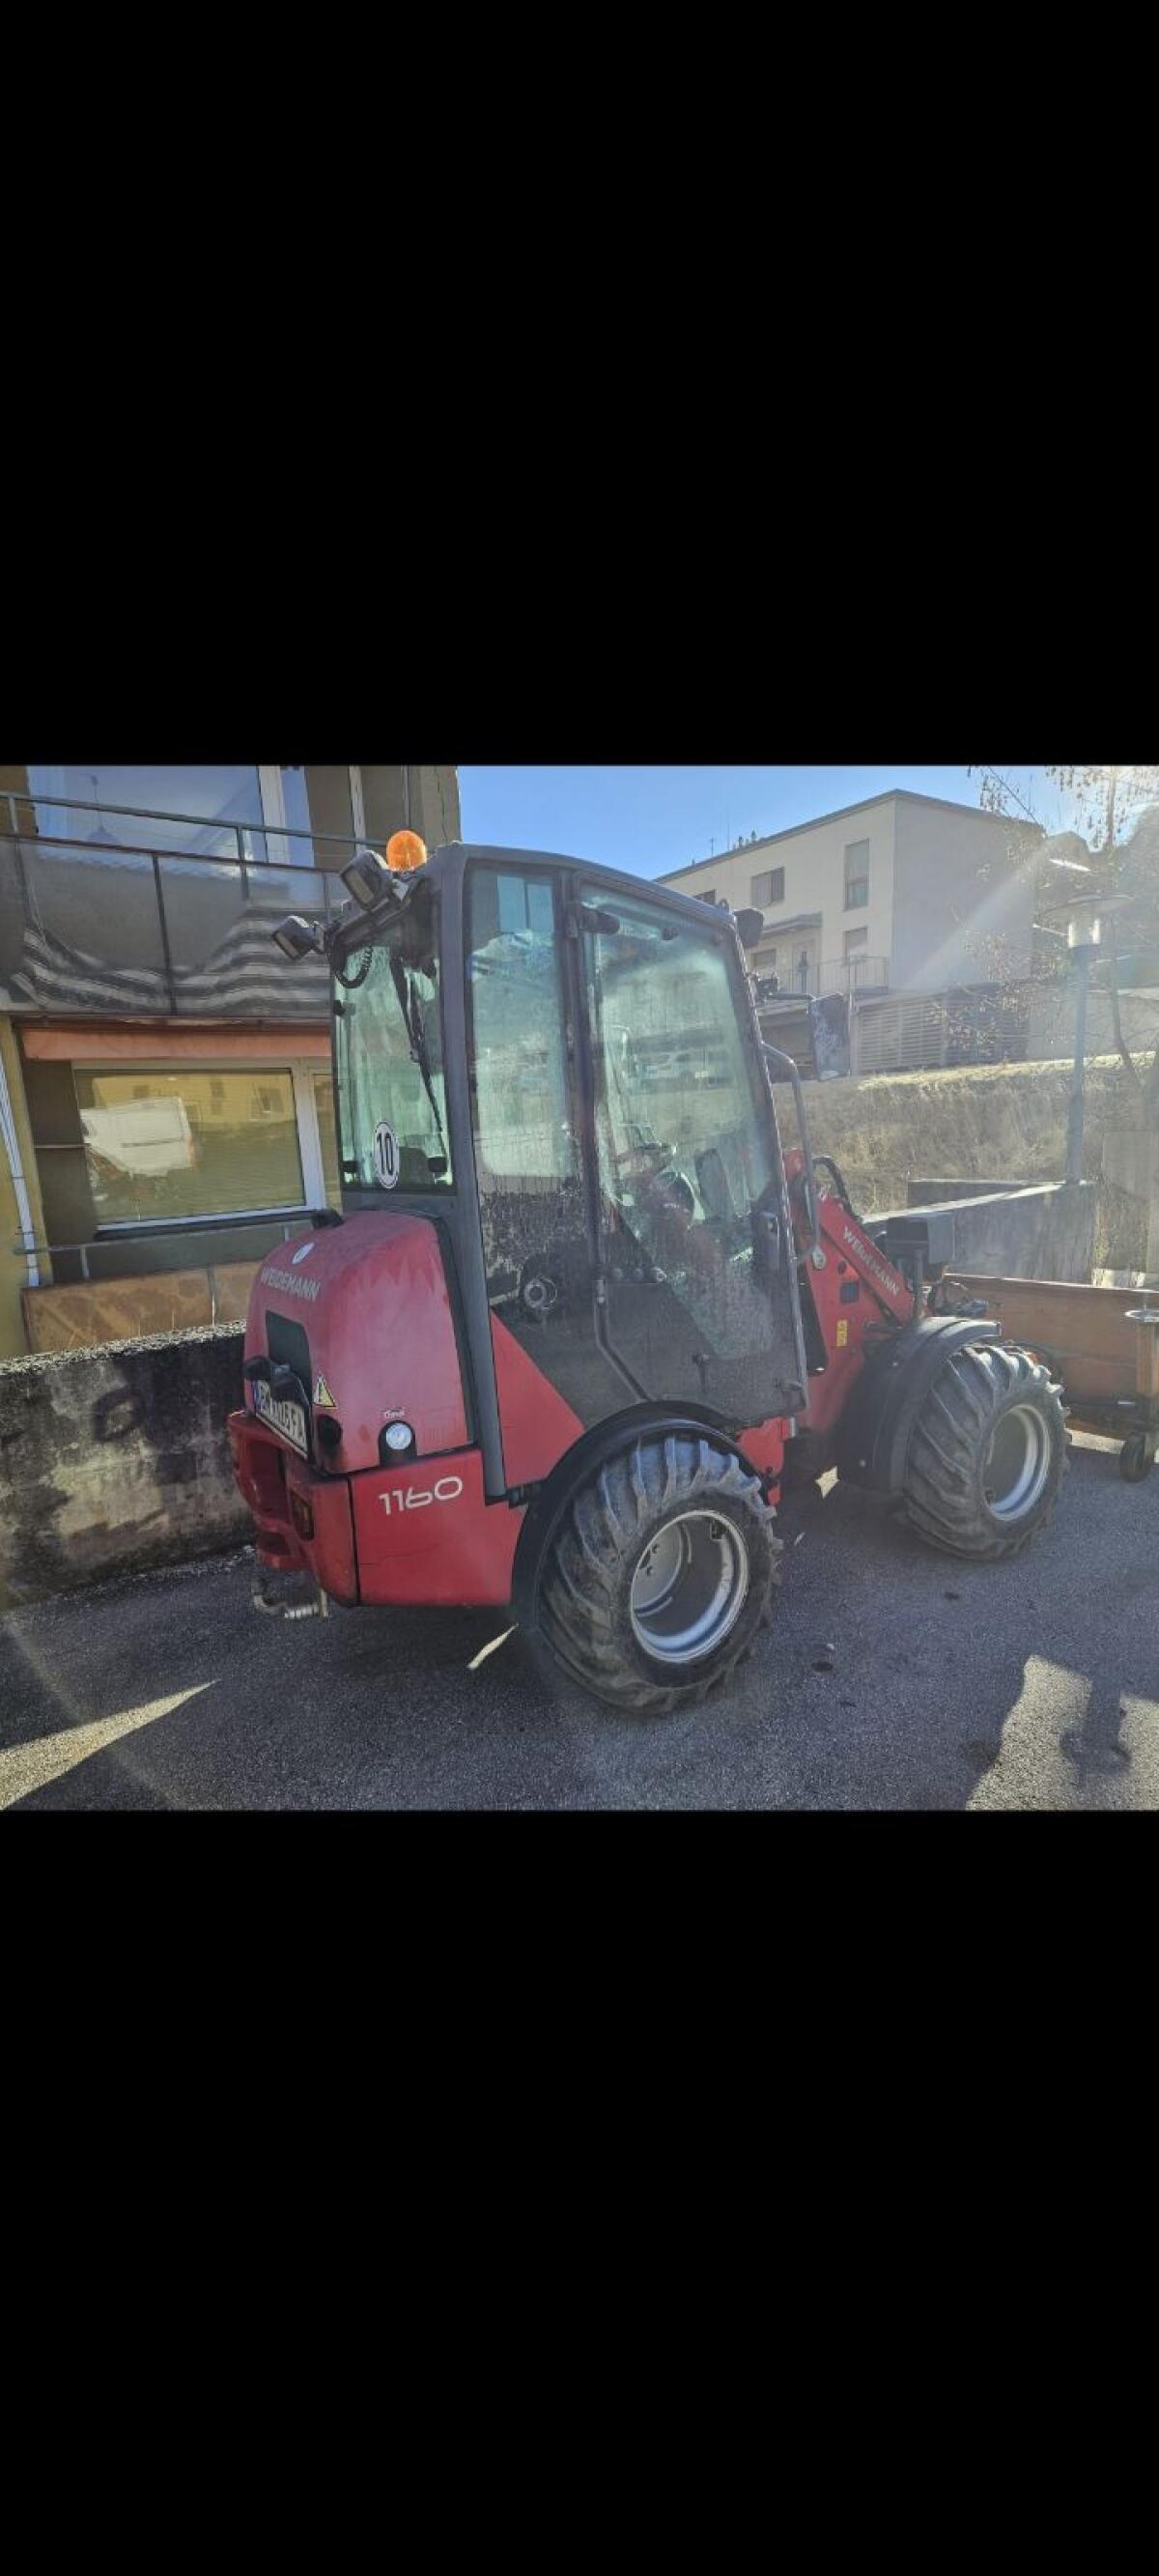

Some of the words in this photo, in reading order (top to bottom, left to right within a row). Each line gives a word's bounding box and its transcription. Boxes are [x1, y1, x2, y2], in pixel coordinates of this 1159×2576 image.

[377, 1132, 394, 1176] 10
[261, 1267, 322, 1302] WEIDEMANN
[379, 1475, 464, 1516] 1160
